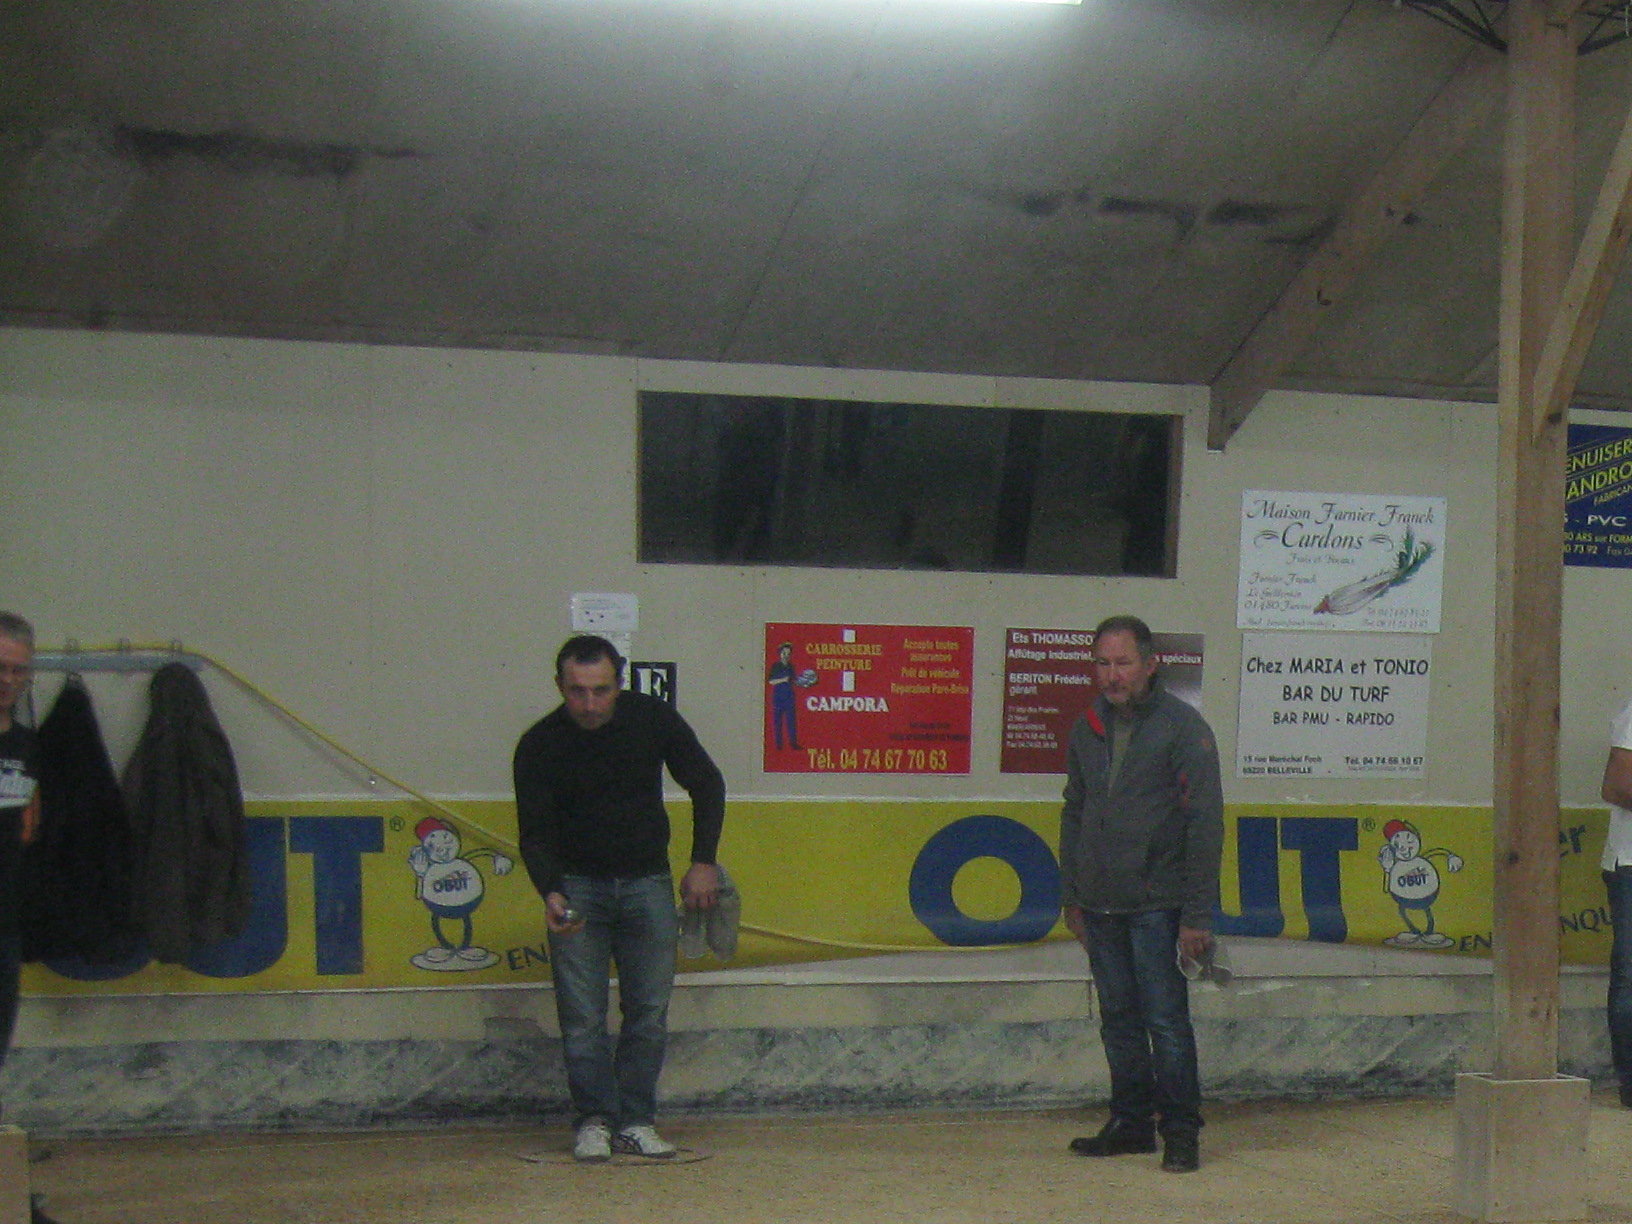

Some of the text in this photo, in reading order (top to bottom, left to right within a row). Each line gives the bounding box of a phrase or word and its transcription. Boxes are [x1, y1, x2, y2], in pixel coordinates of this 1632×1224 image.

[1247, 499, 1311, 520] Maison
[1378, 504, 1435, 527] Franck
[1587, 514, 1627, 527] PVC
[1281, 522, 1365, 550] Cardons
[1606, 546, 1622, 556] Fax
[1012, 632, 1094, 646] Ets THOMASSO
[805, 643, 884, 656] CARROSSERIE
[816, 659, 872, 671] PEINTURE
[1162, 653, 1202, 665] spéciaux
[1247, 657, 1429, 675] Chez MARIA et TONIO
[918, 668, 928, 678] de
[1054, 674, 1092, 685] Frédéric
[636, 668, 668, 702] E
[1283, 685, 1391, 702] BAR DU TURF
[806, 696, 890, 712] CAMPORA
[1273, 712, 1298, 725] BAR
[1302, 712, 1330, 725] PMU
[1346, 712, 1395, 726] RAPIDO
[807, 748, 948, 770] Tél. 04 74 67 70 63
[433, 877, 471, 893] OBUT
[1397, 874, 1429, 889] OBUT
[506, 943, 550, 971] EN
